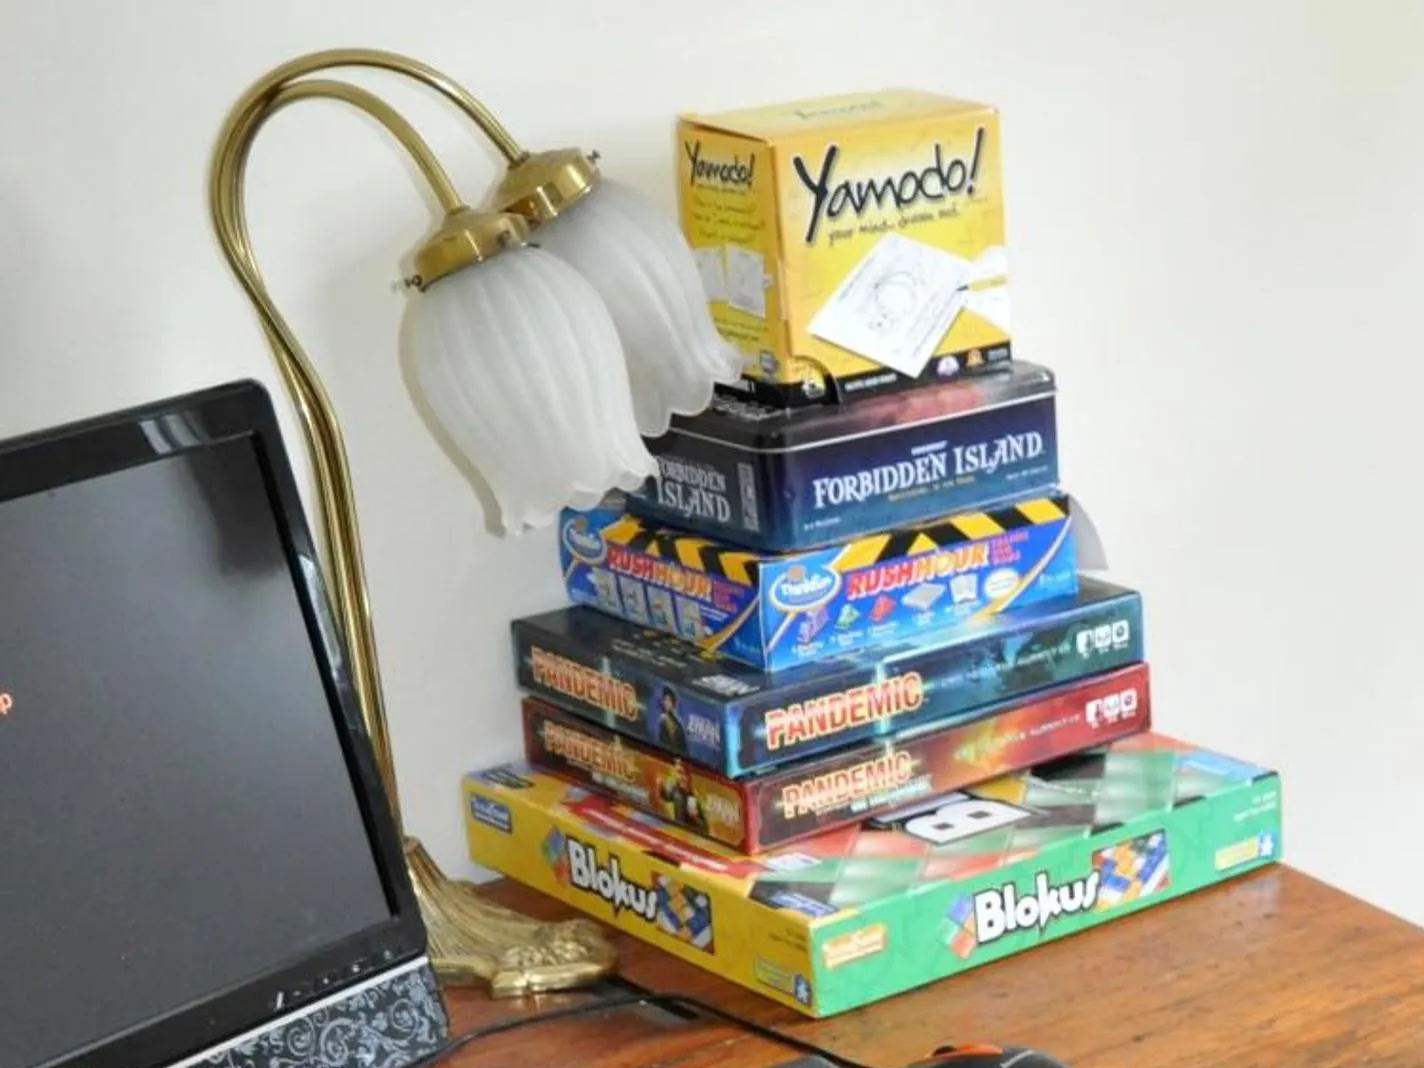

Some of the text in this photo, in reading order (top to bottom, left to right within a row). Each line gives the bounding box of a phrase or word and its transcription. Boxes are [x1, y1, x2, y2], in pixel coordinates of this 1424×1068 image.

[684, 139, 756, 191] Yamodo!
[792, 126, 985, 243] Yamodo!
[656, 474, 732, 523] ISLAND
[658, 458, 728, 493] ORBIDDEN
[812, 451, 948, 509] FORBIDDEN
[951, 431, 1044, 476] ISLAND
[530, 645, 640, 722] PANDEMIC
[765, 671, 924, 750] PANDEMIC
[543, 720, 638, 784] PANDEMIC
[782, 751, 914, 819] PANDEMIC
[566, 836, 658, 921] Blokus
[972, 868, 1102, 945] Blokus
